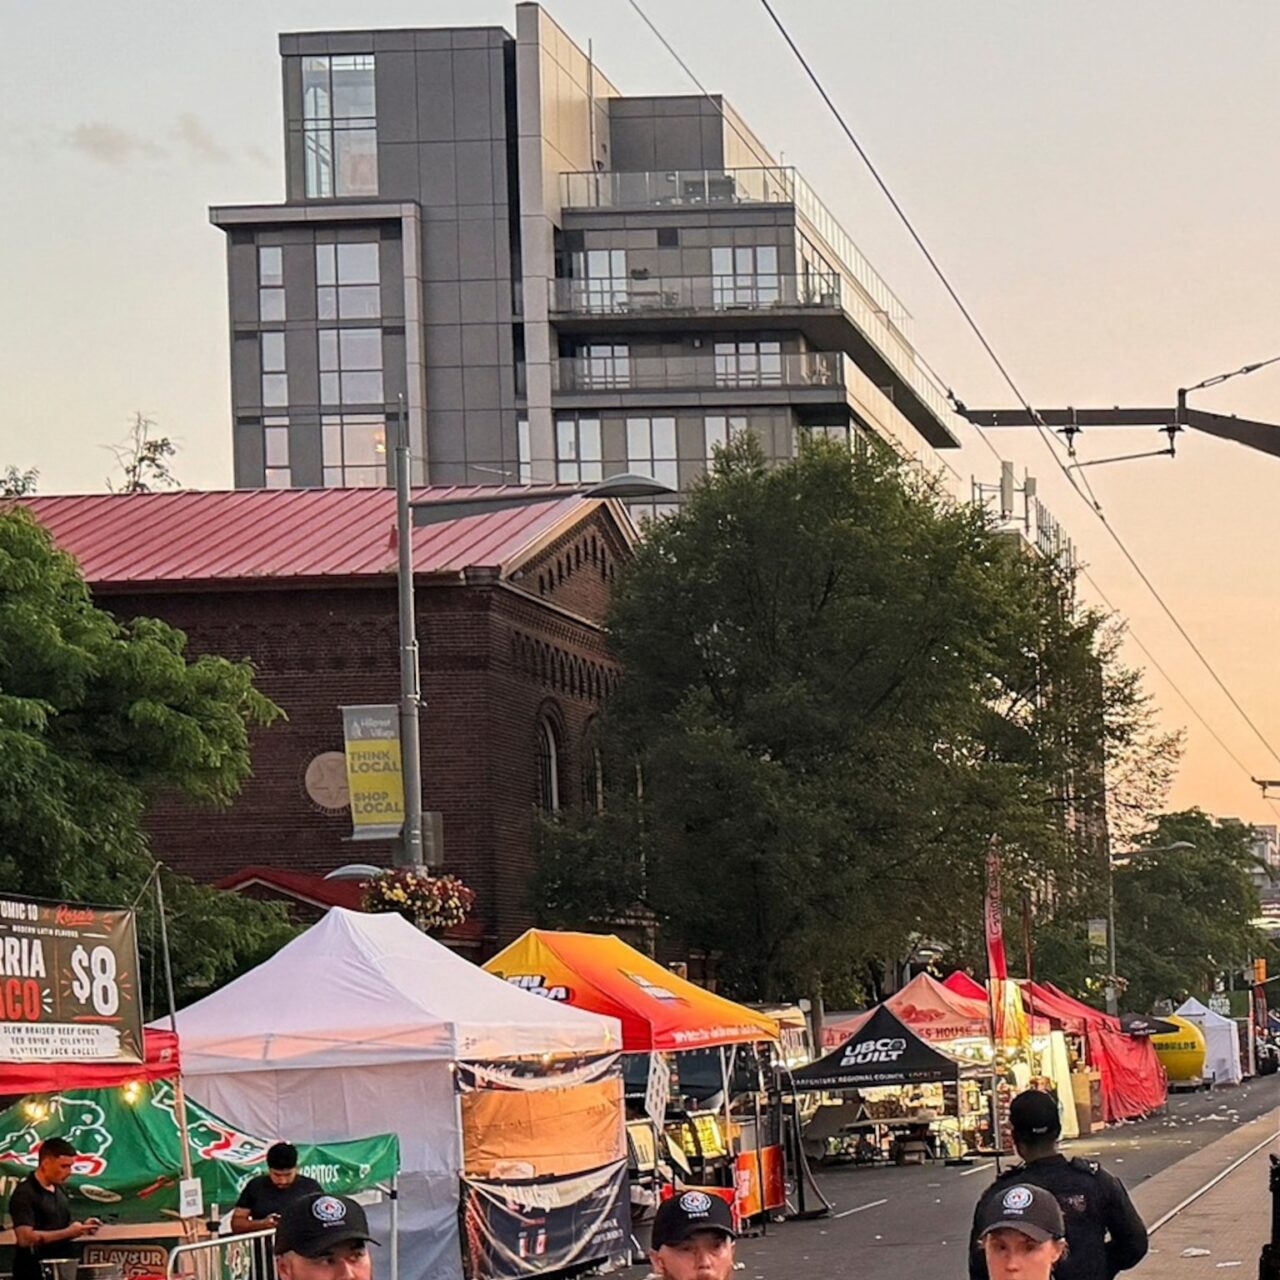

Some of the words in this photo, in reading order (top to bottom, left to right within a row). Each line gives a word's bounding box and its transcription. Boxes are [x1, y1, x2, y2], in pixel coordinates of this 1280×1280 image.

[351, 751, 390, 762] THINK
[350, 762, 400, 774] LOCAL
[354, 792, 389, 802] SHOP
[355, 802, 404, 814] LOCAL
[0, 900, 27, 920] OMIC
[28, 904, 38, 921] 10
[71, 944, 119, 1016] $8
[3, 1026, 22, 1034] SLOW
[25, 1027, 56, 1035] BRAISED
[840, 1051, 903, 1066] BUILT
[838, 1074, 873, 1084] REGIONAL
[300, 1164, 340, 1183] RRITOS
